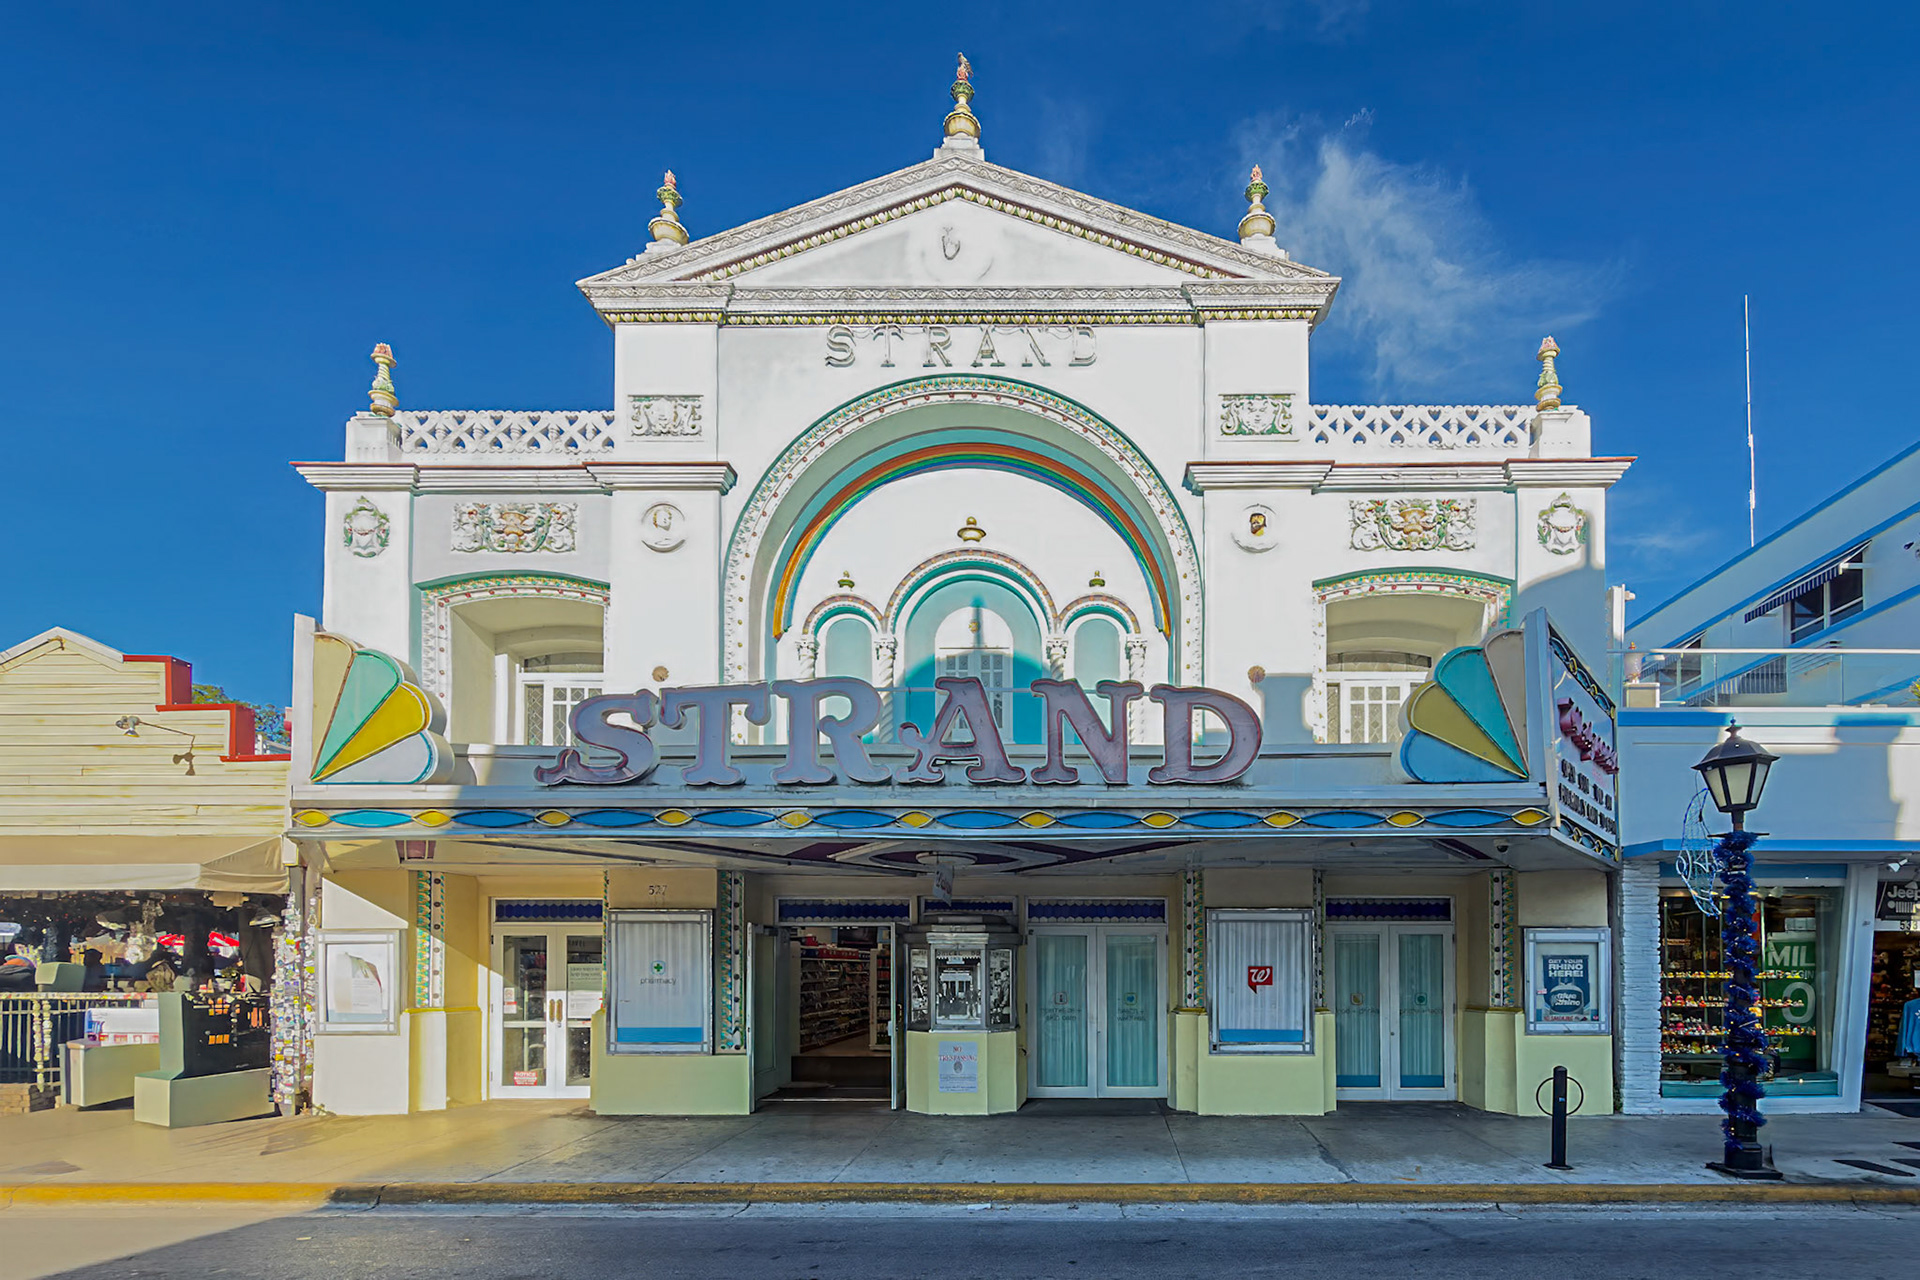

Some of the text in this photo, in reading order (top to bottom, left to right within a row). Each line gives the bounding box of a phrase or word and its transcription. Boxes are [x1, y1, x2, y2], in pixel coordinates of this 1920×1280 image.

[825, 324, 1097, 367] STRAND
[533, 676, 1264, 786] STRAND
[648, 885, 668, 896] 527
[640, 977, 677, 986] pharmacy
[1250, 968, 1270, 983] W
